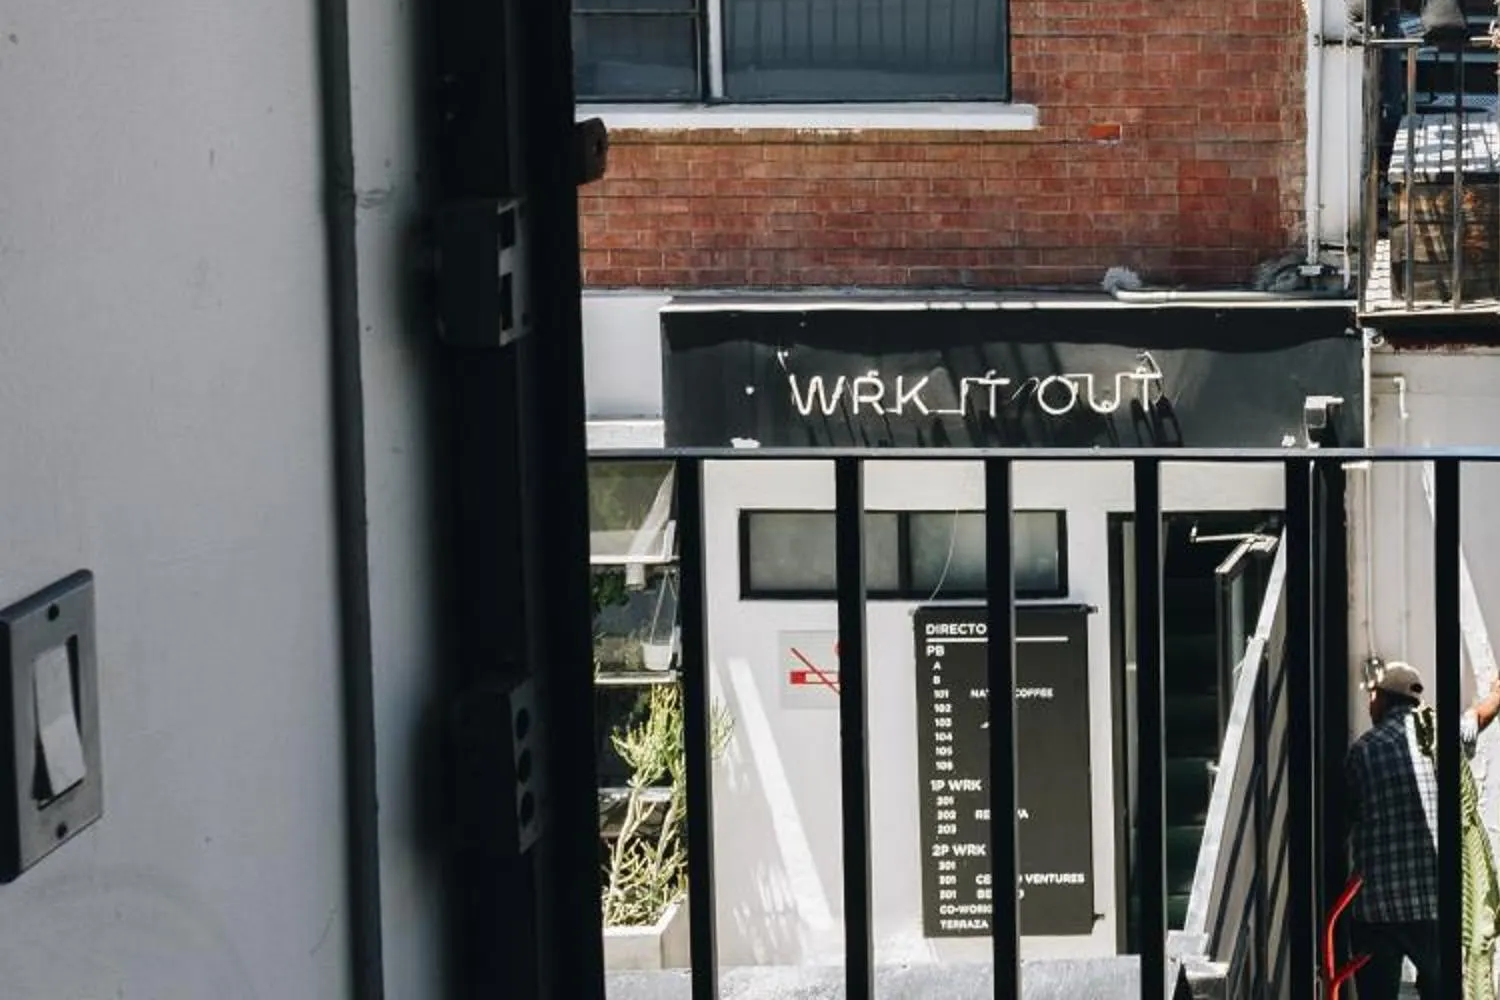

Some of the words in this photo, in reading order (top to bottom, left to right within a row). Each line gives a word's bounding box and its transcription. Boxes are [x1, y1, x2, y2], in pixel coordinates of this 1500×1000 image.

[789, 369, 930, 417] WRK
[961, 369, 1011, 418] IT
[1036, 365, 1163, 415] OUT
[925, 623, 987, 635] DIRECTO
[926, 645, 945, 657] PB
[947, 779, 982, 792] WRK
[951, 843, 987, 857] WRK
